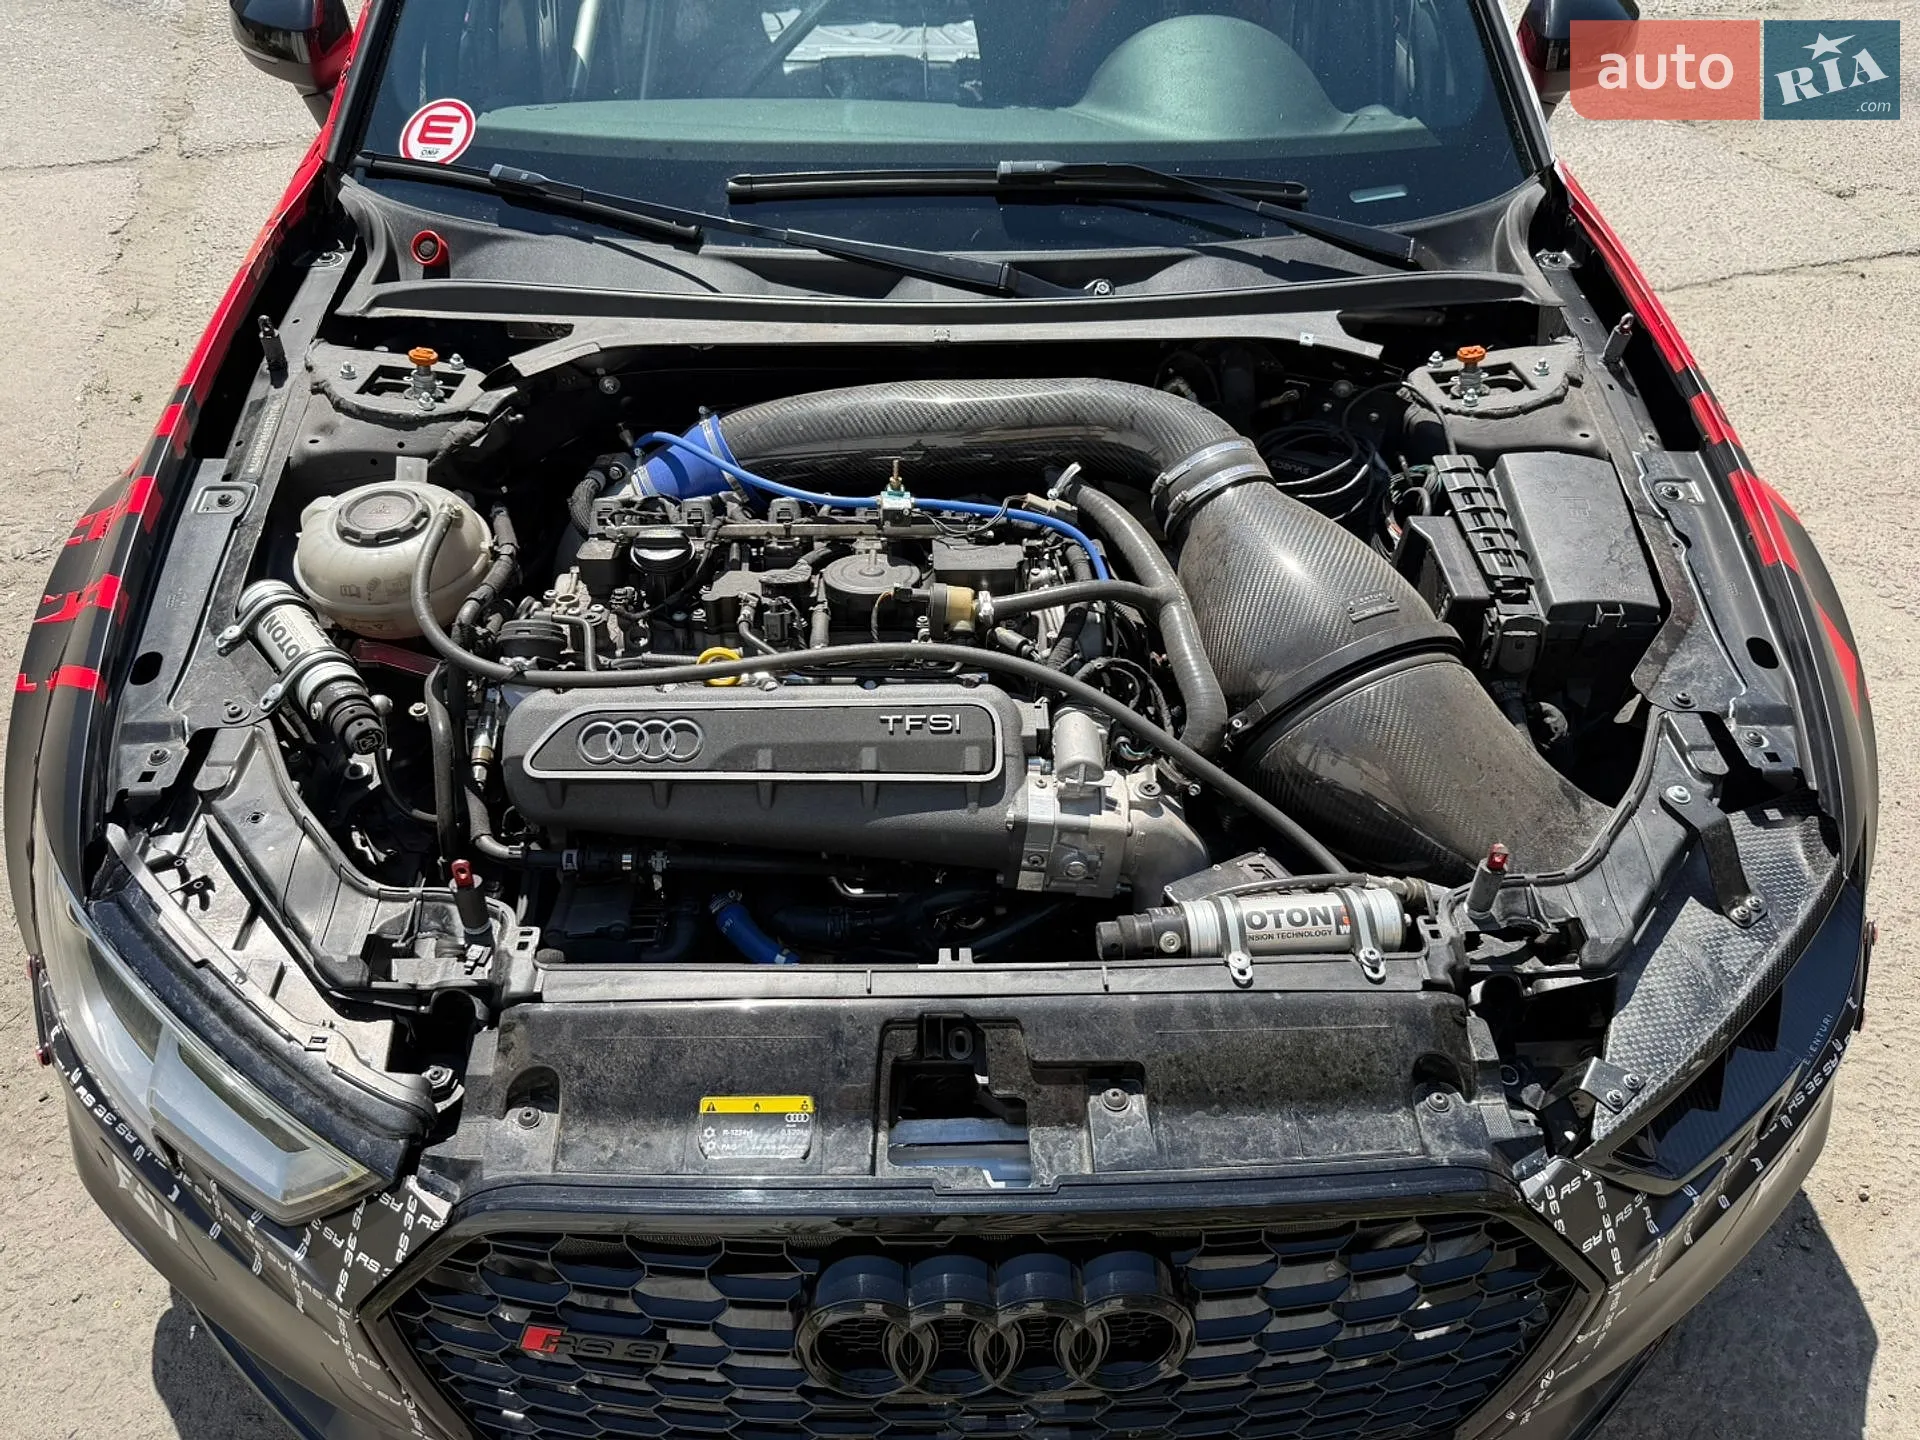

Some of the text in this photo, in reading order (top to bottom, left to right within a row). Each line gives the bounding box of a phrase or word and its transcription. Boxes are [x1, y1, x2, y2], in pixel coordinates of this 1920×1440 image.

[263, 614, 301, 661] OTON
[880, 714, 961, 735] TFSI
[1245, 906, 1332, 931] OTON
[1247, 929, 1333, 941] NSION TECHNOLOGY
[1805, 1014, 1833, 1065] EVENTURI
[75, 1085, 95, 1107] RS
[1560, 1176, 1581, 1200] RS
[1615, 1204, 1632, 1228] RS
[356, 1252, 381, 1273] RS
